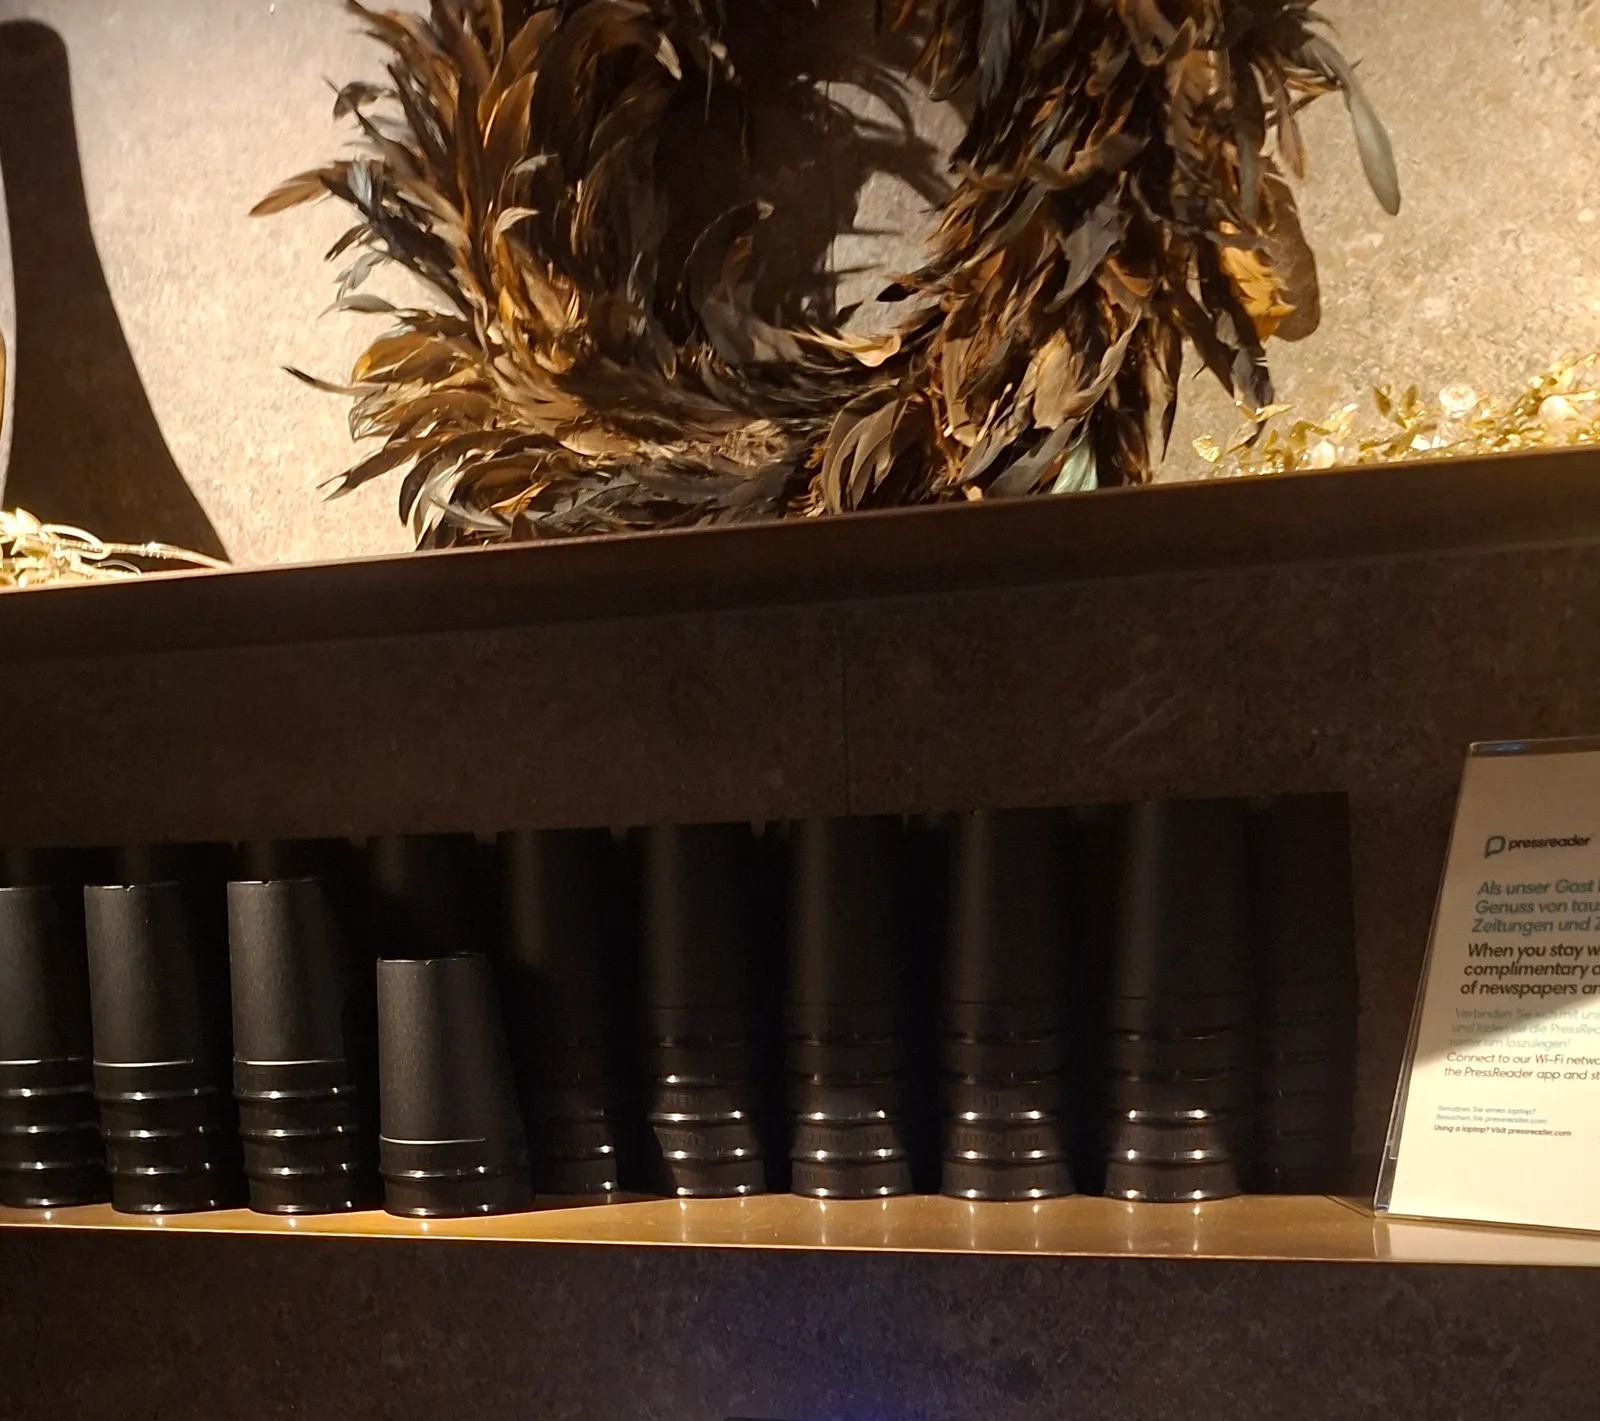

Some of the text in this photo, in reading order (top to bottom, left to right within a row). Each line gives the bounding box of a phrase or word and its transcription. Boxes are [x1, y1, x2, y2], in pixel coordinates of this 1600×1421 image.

[1508, 834, 1592, 850] pressreader
[1478, 880, 1502, 895] Als
[1506, 883, 1549, 895] unser
[1555, 879, 1594, 893] Gast
[1475, 900, 1535, 914] Genuss
[1539, 902, 1567, 913] von
[1471, 918, 1553, 936] Zeitungen
[1558, 916, 1591, 931] und
[1468, 942, 1513, 958] When
[1517, 946, 1546, 963] you
[1550, 943, 1584, 961] stay
[1463, 961, 1589, 980] complimentary
[1460, 980, 1478, 995] of
[1480, 983, 1578, 999] newspapers
[1446, 1051, 1496, 1064] Connect
[1498, 1053, 1510, 1064] to
[1512, 1055, 1532, 1065] our
[1535, 1053, 1564, 1065] Wi-Fi
[1444, 1067, 1462, 1077] the
[1464, 1067, 1534, 1079] PressReader
[1536, 1071, 1561, 1082] app
[1564, 1070, 1588, 1080] and
[1434, 1124, 1453, 1133] Using
[1462, 1125, 1490, 1134] laptop?
[1491, 1126, 1507, 1134] Visit
